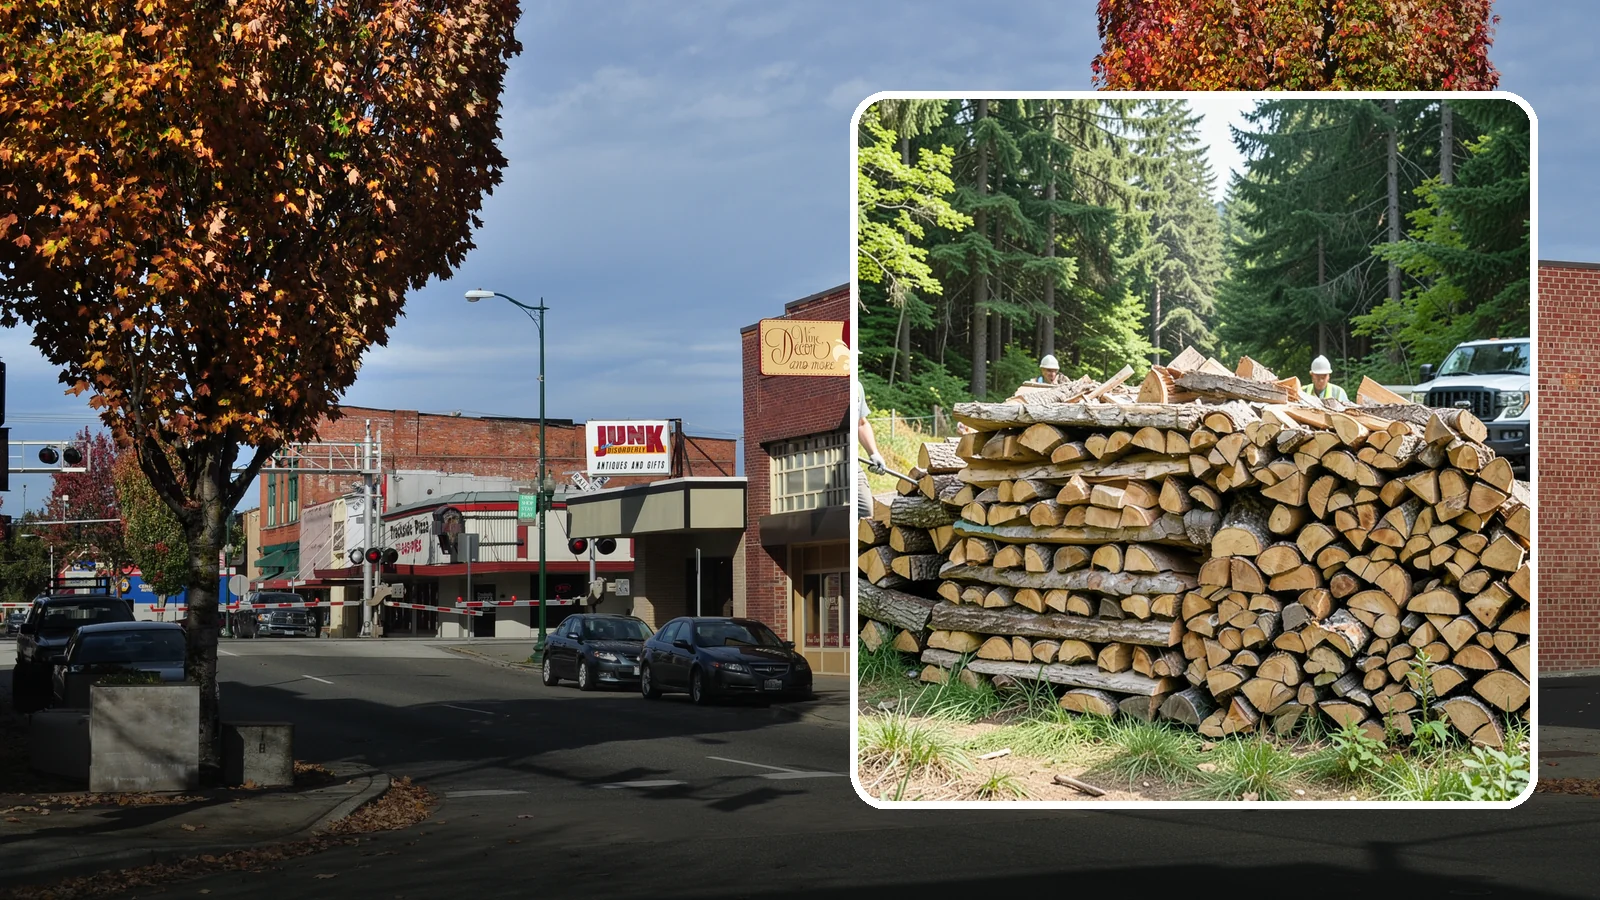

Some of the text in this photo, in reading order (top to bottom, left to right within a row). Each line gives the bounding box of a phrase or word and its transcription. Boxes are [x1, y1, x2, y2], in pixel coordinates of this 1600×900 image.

[595, 425, 665, 457] JUNK
[597, 460, 665, 470] ANTIQUES AND GIFTS
[390, 519, 429, 539] Trackside Pizza
